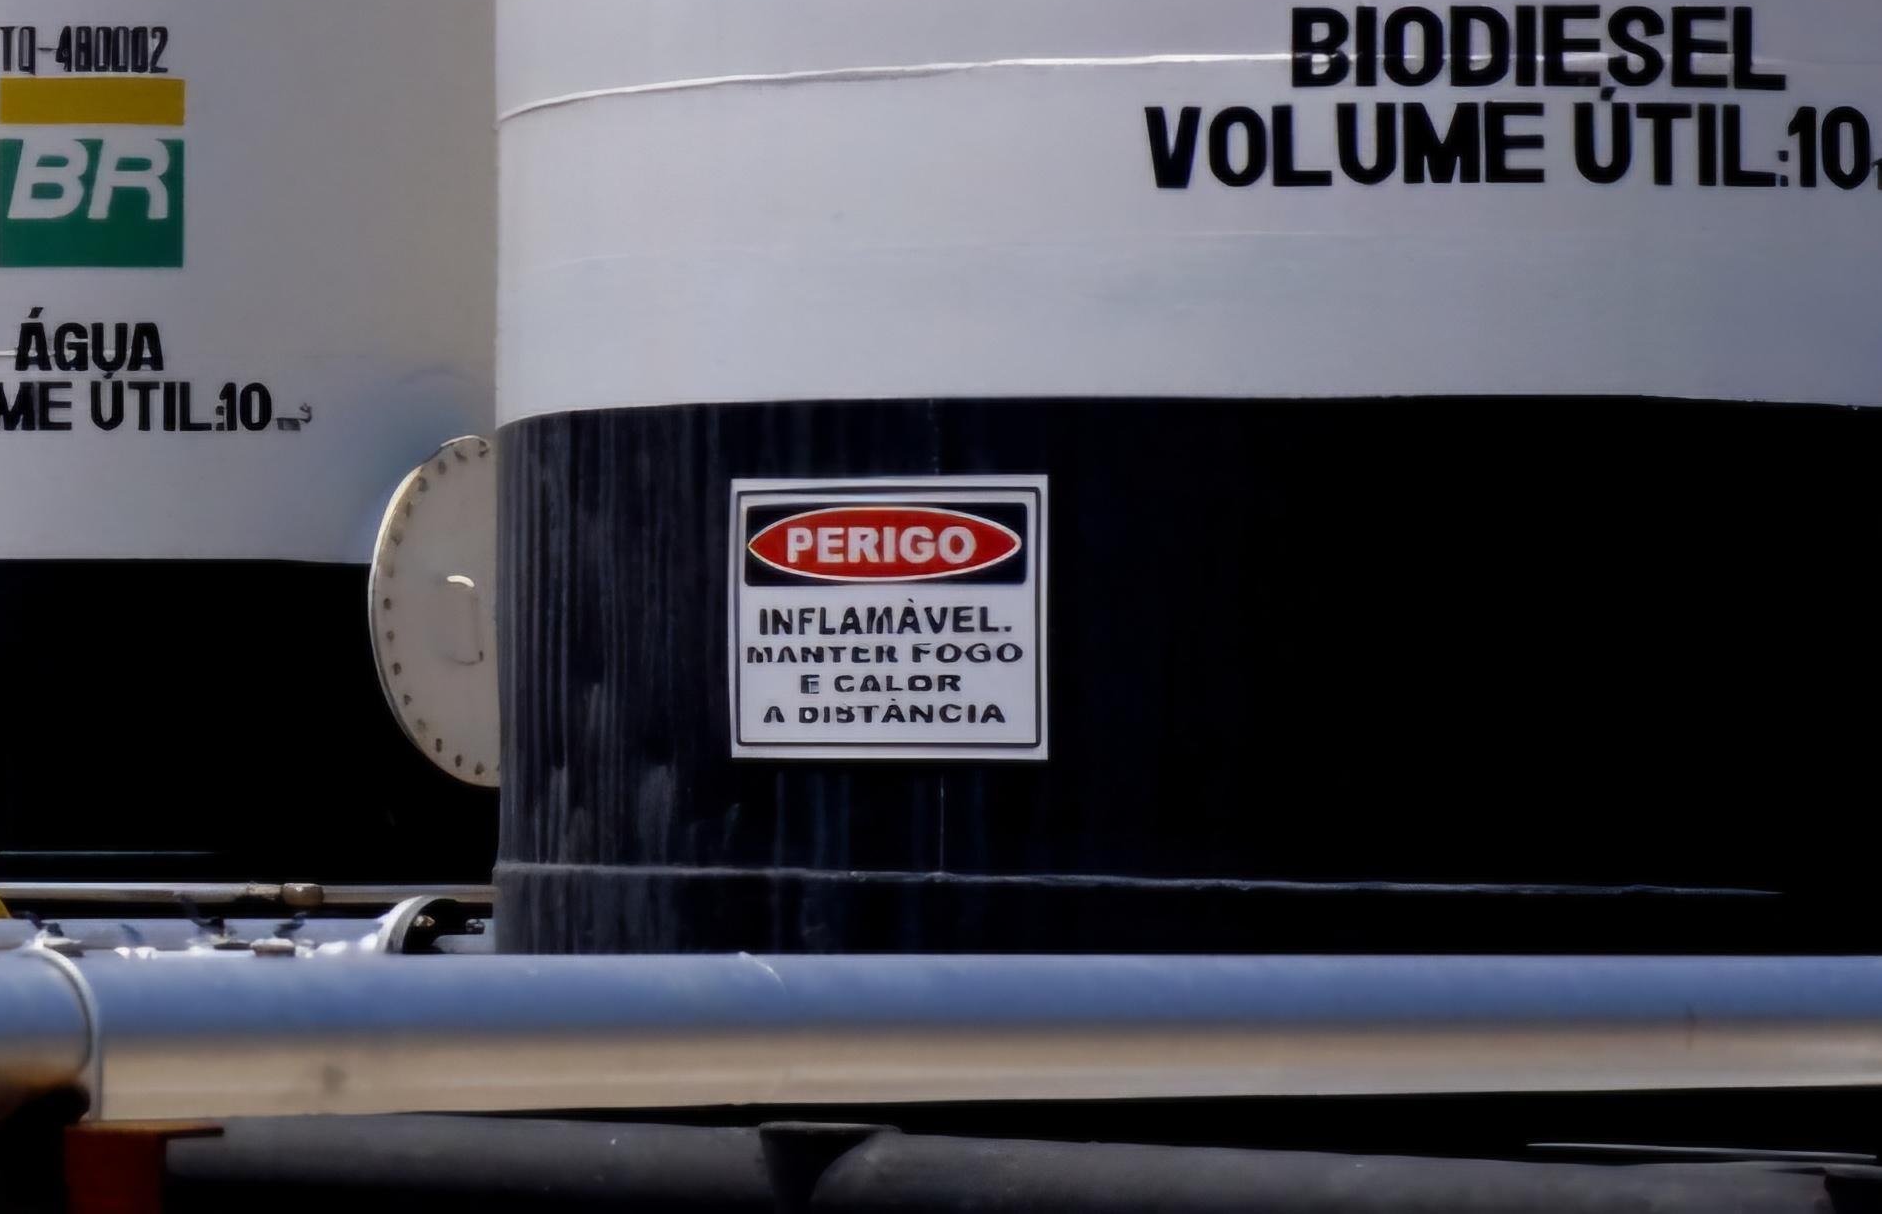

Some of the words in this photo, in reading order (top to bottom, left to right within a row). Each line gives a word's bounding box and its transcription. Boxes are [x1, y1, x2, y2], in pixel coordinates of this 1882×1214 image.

[1291, 4, 1787, 91] BIODIESEL
[1144, 100, 1546, 190] VOLUME
[1572, 86, 1882, 191] ÚTIL:10
[6, 138, 170, 220] BR
[14, 306, 165, 372] ÁGUA
[786, 525, 977, 565] PERIGO
[746, 643, 899, 664] MANTER
[911, 642, 1024, 664] FOGO
[800, 674, 821, 694] E
[834, 674, 962, 693] CALOR
